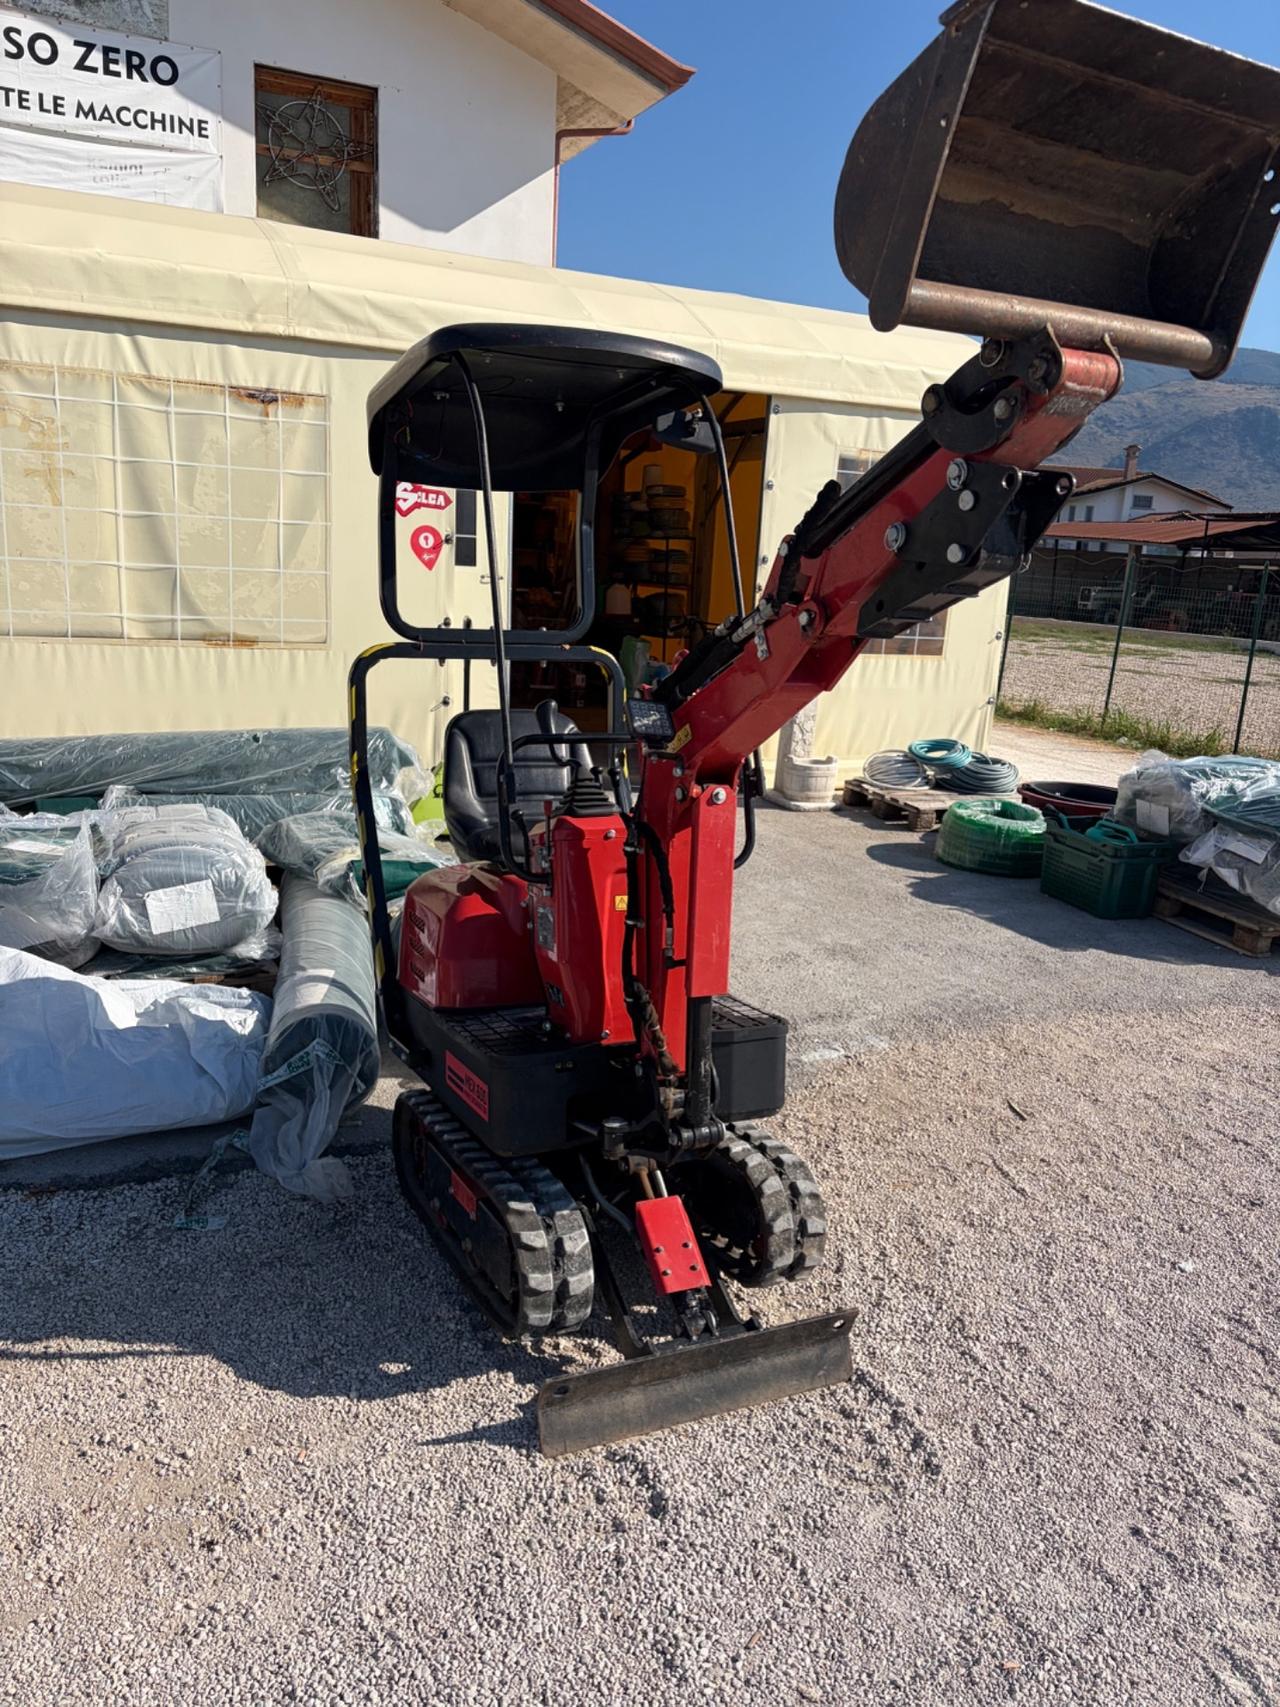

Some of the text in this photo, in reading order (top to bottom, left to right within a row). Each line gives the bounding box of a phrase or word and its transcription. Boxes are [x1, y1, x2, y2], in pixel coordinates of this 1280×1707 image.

[3, 26, 179, 86] SO ZERO
[0, 86, 209, 139] TE LE MACCHINE
